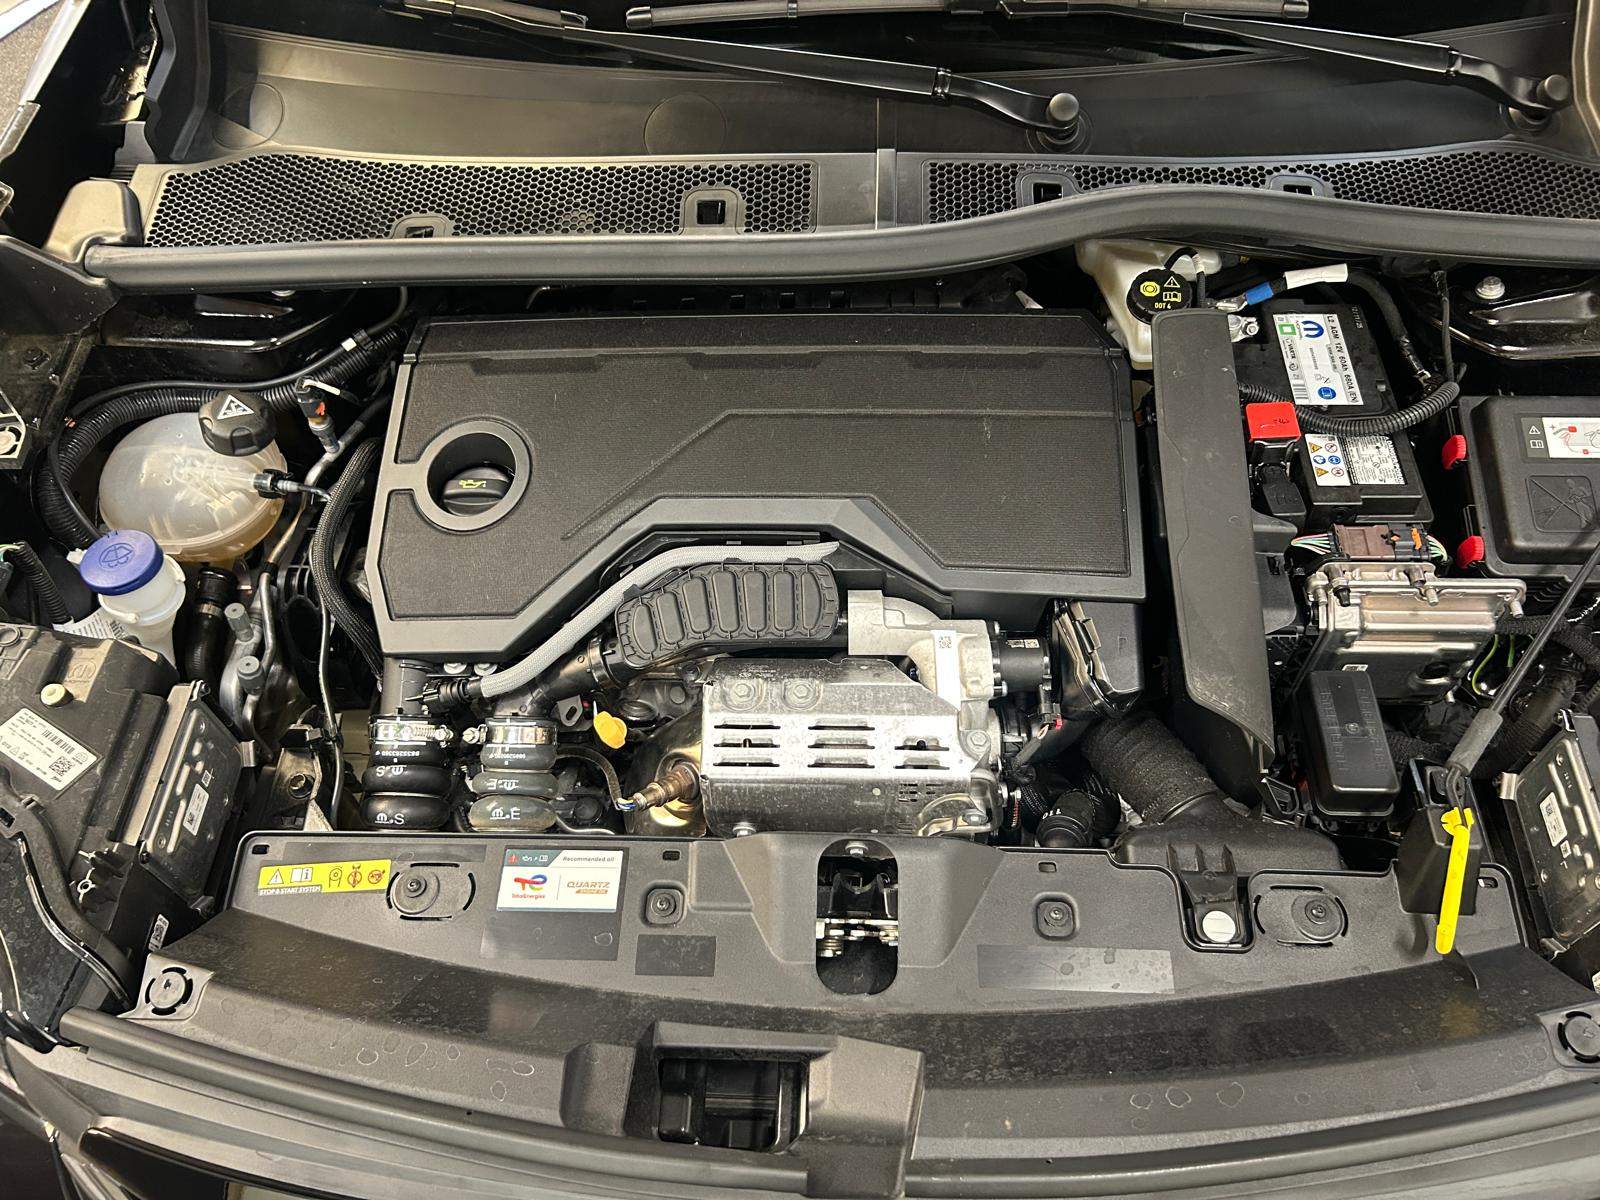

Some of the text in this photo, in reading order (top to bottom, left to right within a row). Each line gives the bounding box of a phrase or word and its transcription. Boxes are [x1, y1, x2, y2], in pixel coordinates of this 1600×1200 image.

[1327, 315, 1335, 323] L2
[1330, 325, 1340, 339] AGM
[1335, 342, 1344, 353] 12V
[1339, 356, 1349, 372] 60Ah
[566, 881, 610, 889] QUARTZ
